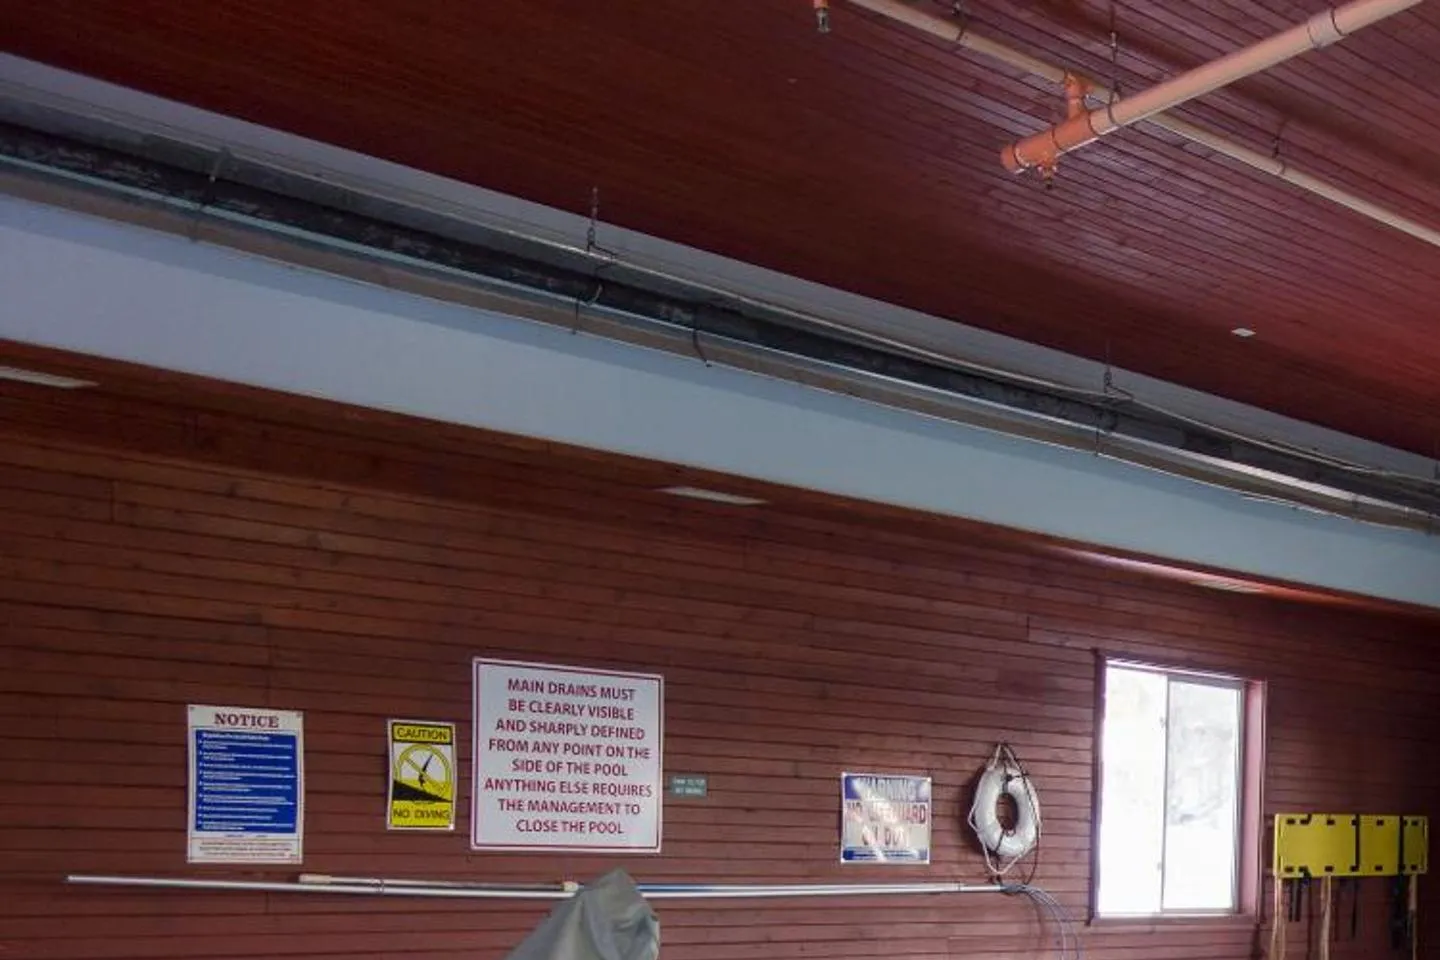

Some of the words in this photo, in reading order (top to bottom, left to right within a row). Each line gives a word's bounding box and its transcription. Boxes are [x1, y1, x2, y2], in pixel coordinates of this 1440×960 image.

[507, 679, 545, 694] MAIN
[548, 682, 598, 699] DRAINS
[600, 687, 636, 701] MUST
[508, 699, 526, 713] BE
[529, 700, 585, 717] CLEARLY
[588, 706, 635, 721] VISIBLE
[214, 713, 280, 728] NOTICE
[496, 719, 527, 733] AND
[529, 720, 588, 737] SHARPLY
[591, 725, 645, 740] DEFINED
[397, 727, 448, 740] CAUTION
[488, 738, 529, 752] FROM
[531, 741, 560, 753] ANY
[563, 743, 604, 756] POINT
[606, 745, 625, 758] ON
[627, 746, 651, 760] THE
[511, 758, 542, 773] SIDE
[545, 761, 564, 773] OF
[566, 762, 591, 775] THE
[594, 763, 629, 777] POOL
[484, 778, 556, 793] ANYTHING
[559, 781, 589, 794] ELSE
[592, 783, 653, 798] REQUIRES
[393, 807, 410, 818] NO
[414, 808, 450, 820] DIVING
[497, 798, 524, 812] THE
[527, 799, 622, 815] MANAGEMENT
[623, 803, 641, 816] TO
[516, 819, 557, 833] CLOSE
[562, 820, 585, 834] THE
[588, 821, 625, 835] POOL
